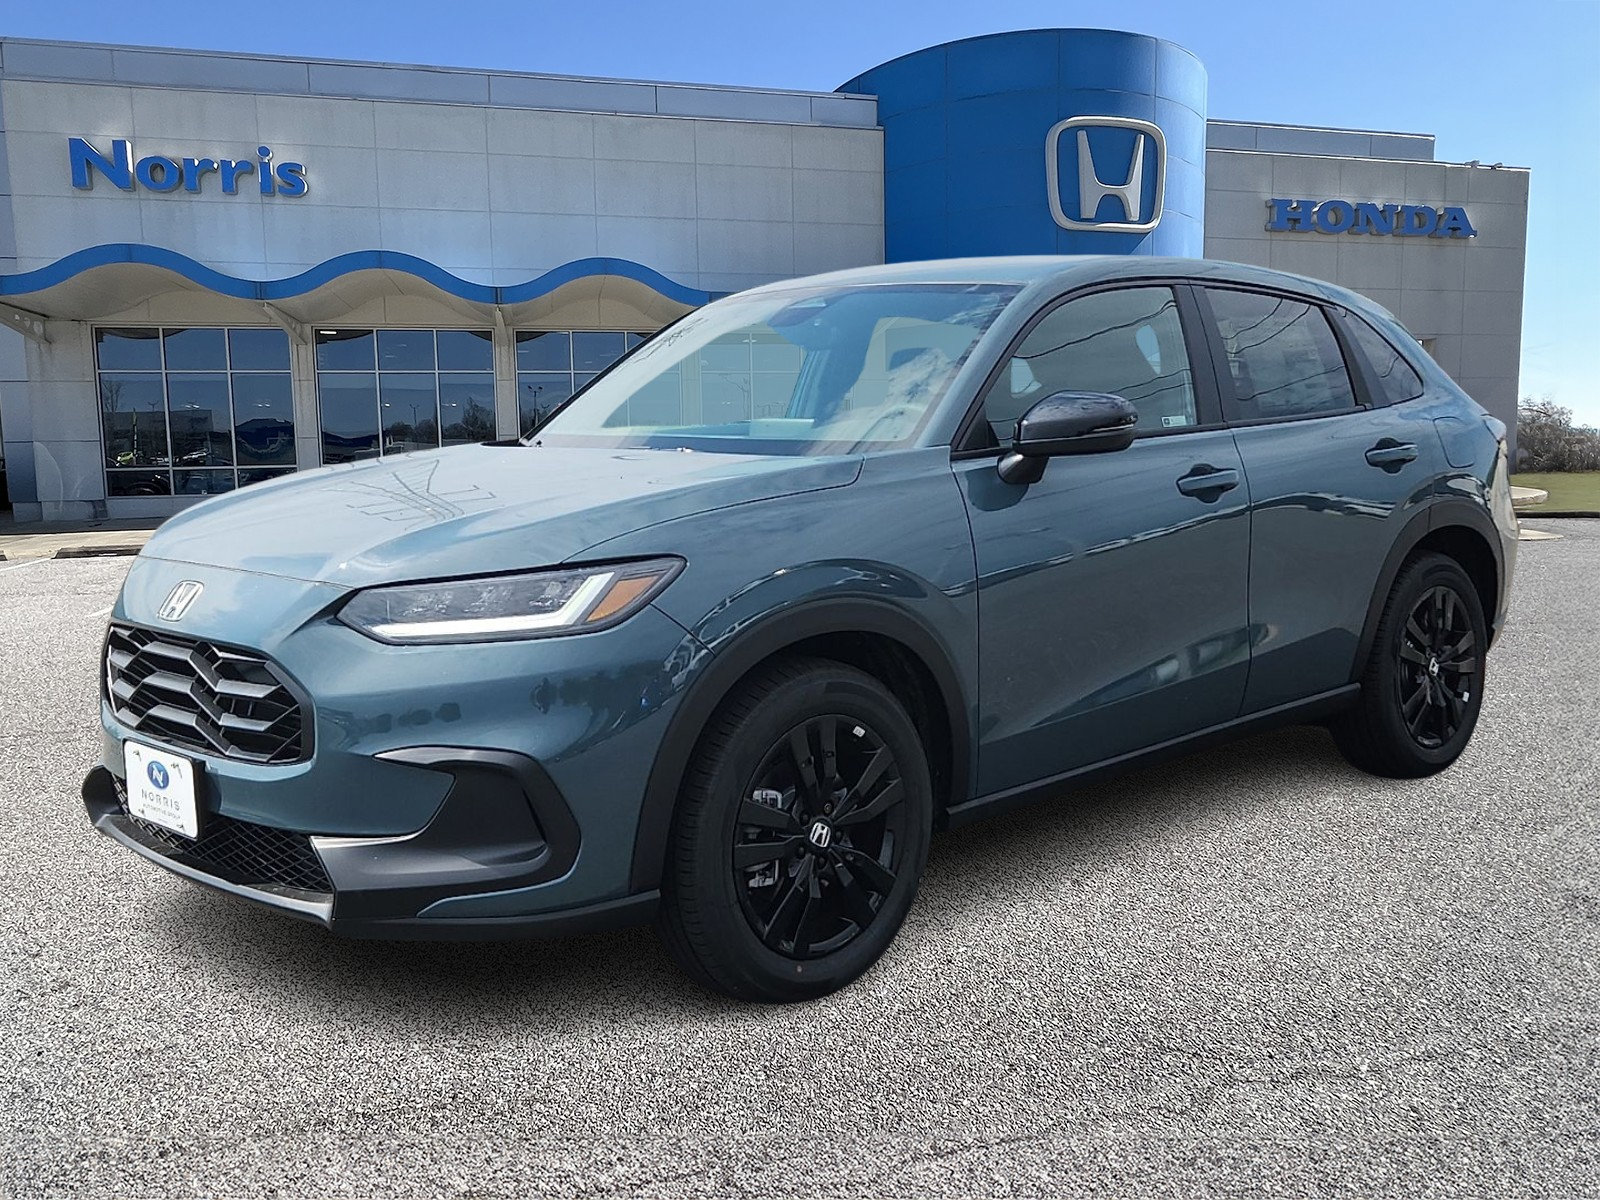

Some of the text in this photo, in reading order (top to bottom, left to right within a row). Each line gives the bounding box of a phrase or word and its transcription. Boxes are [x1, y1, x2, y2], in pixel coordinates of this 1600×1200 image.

[67, 137, 309, 198] Norris
[1265, 198, 1478, 239] HONDA
[141, 788, 180, 811] NORRIS
